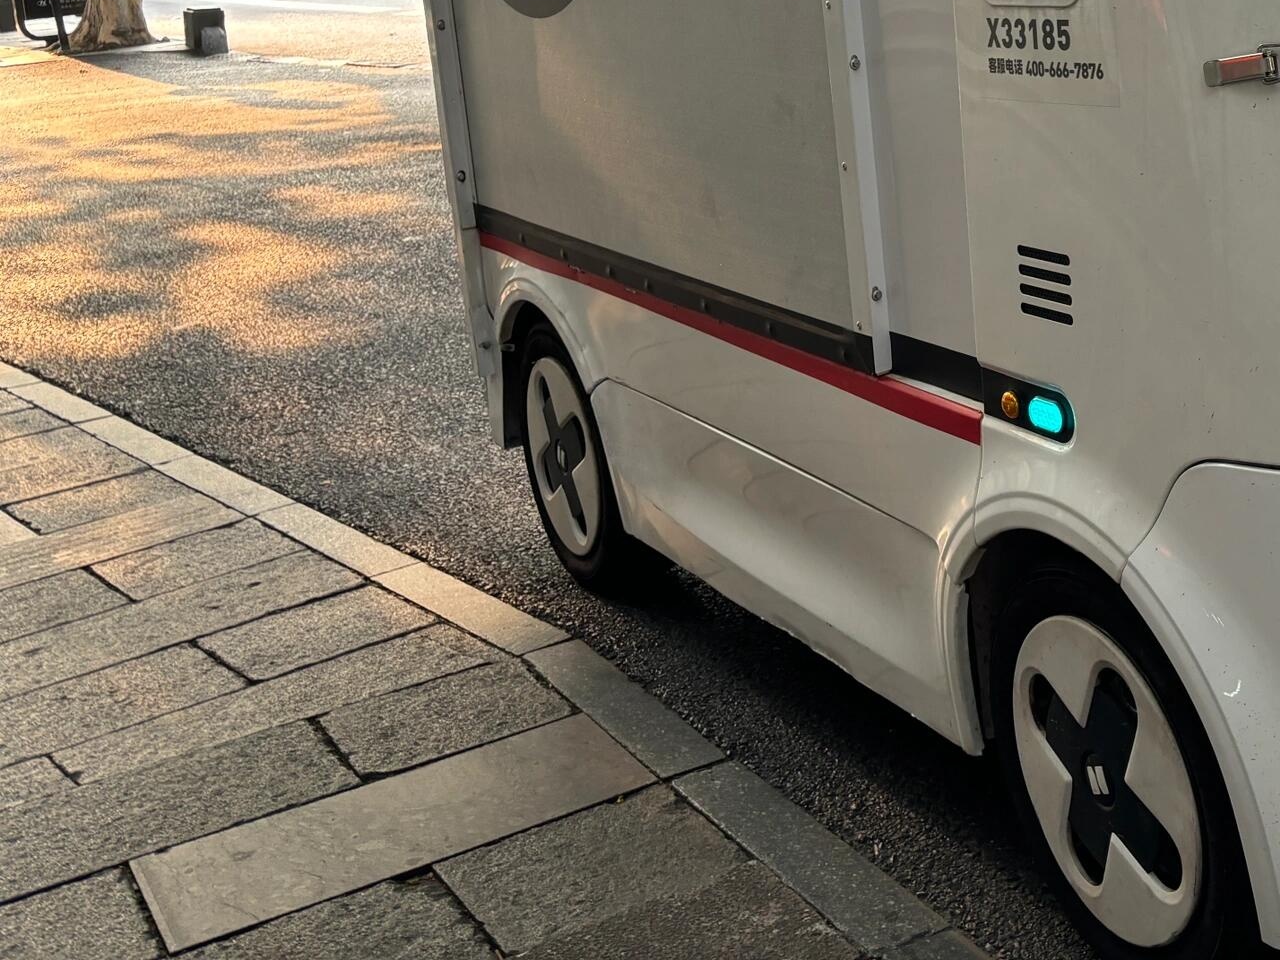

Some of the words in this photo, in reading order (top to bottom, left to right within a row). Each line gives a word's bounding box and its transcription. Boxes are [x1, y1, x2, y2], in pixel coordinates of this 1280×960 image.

[986, 17, 1071, 51] X33185
[988, 57, 1023, 75] 客服电话
[1026, 60, 1104, 80] 400-666-7876
